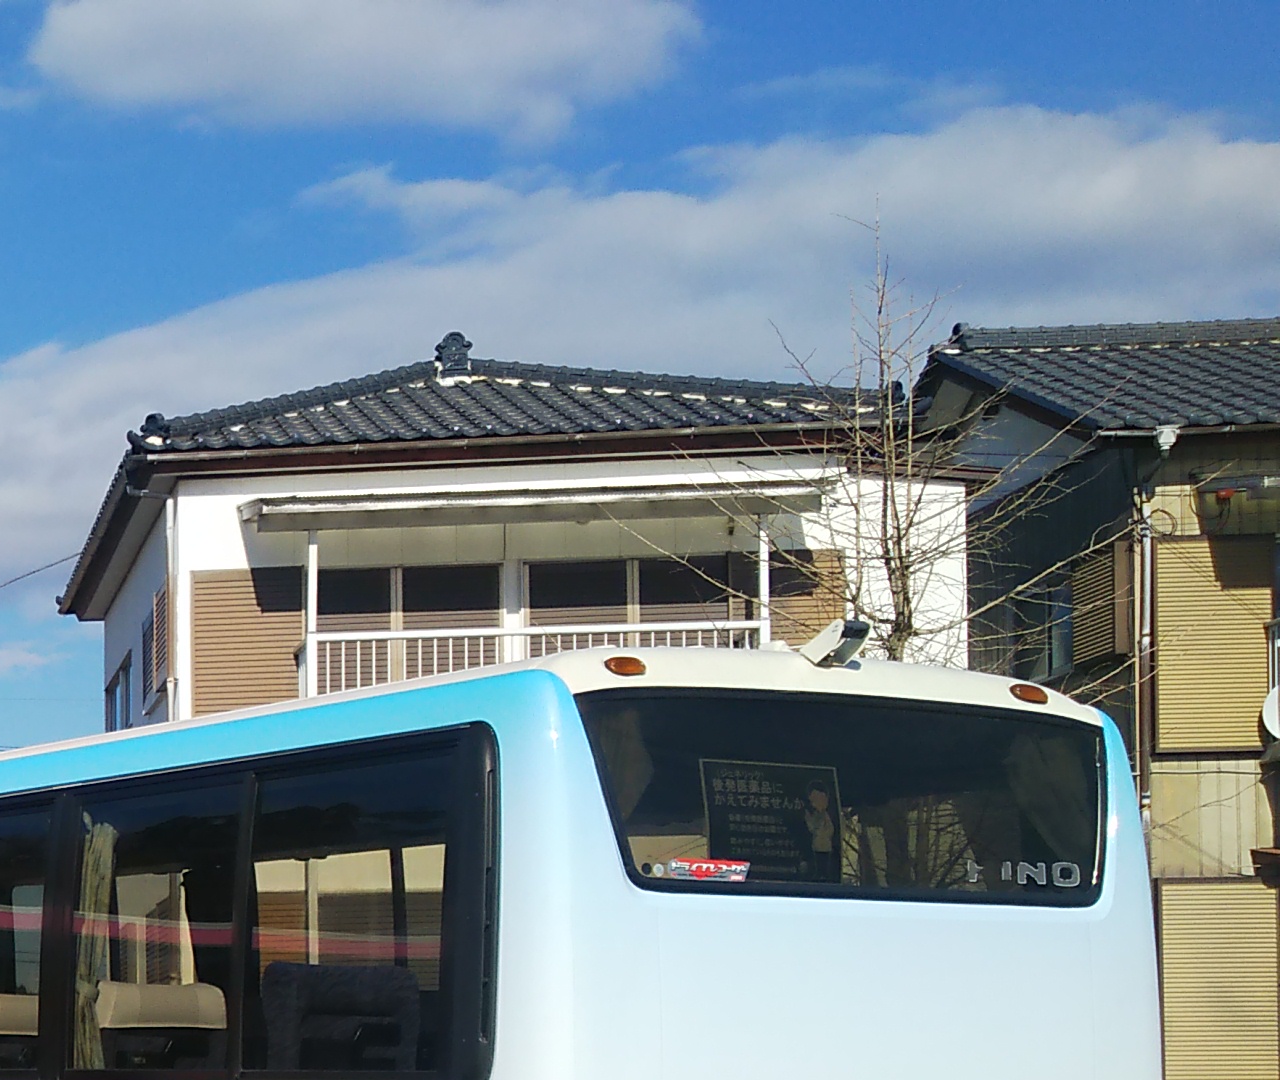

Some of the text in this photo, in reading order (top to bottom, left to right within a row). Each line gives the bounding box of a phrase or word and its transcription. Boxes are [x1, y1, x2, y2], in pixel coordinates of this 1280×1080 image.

[714, 793, 805, 810] かえてみませんか
